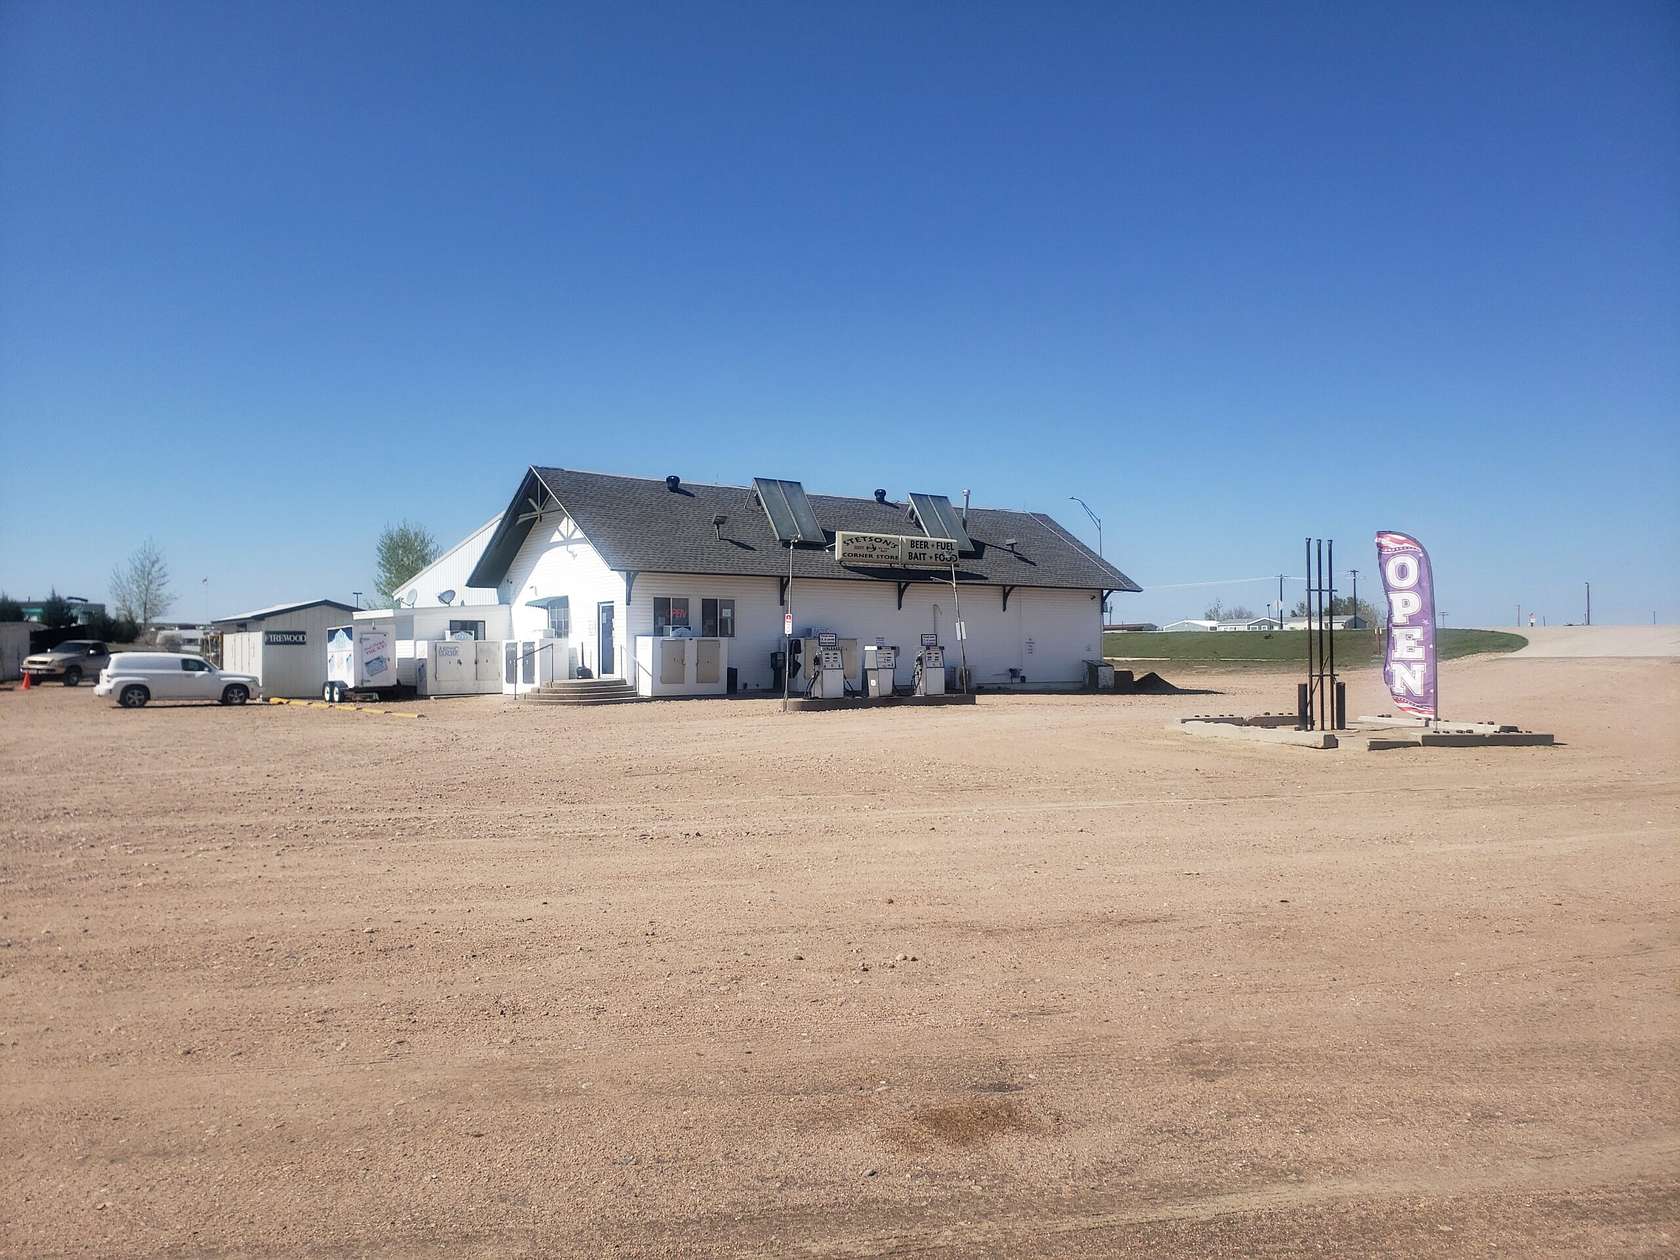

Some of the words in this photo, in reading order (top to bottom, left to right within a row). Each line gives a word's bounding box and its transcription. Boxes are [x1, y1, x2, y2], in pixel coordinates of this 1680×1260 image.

[843, 536, 899, 549] STETSON'S
[910, 540, 930, 550] BEER
[936, 541, 955, 551] FUEL
[908, 552, 927, 561] BAIT
[1386, 554, 1426, 697] OPEN
